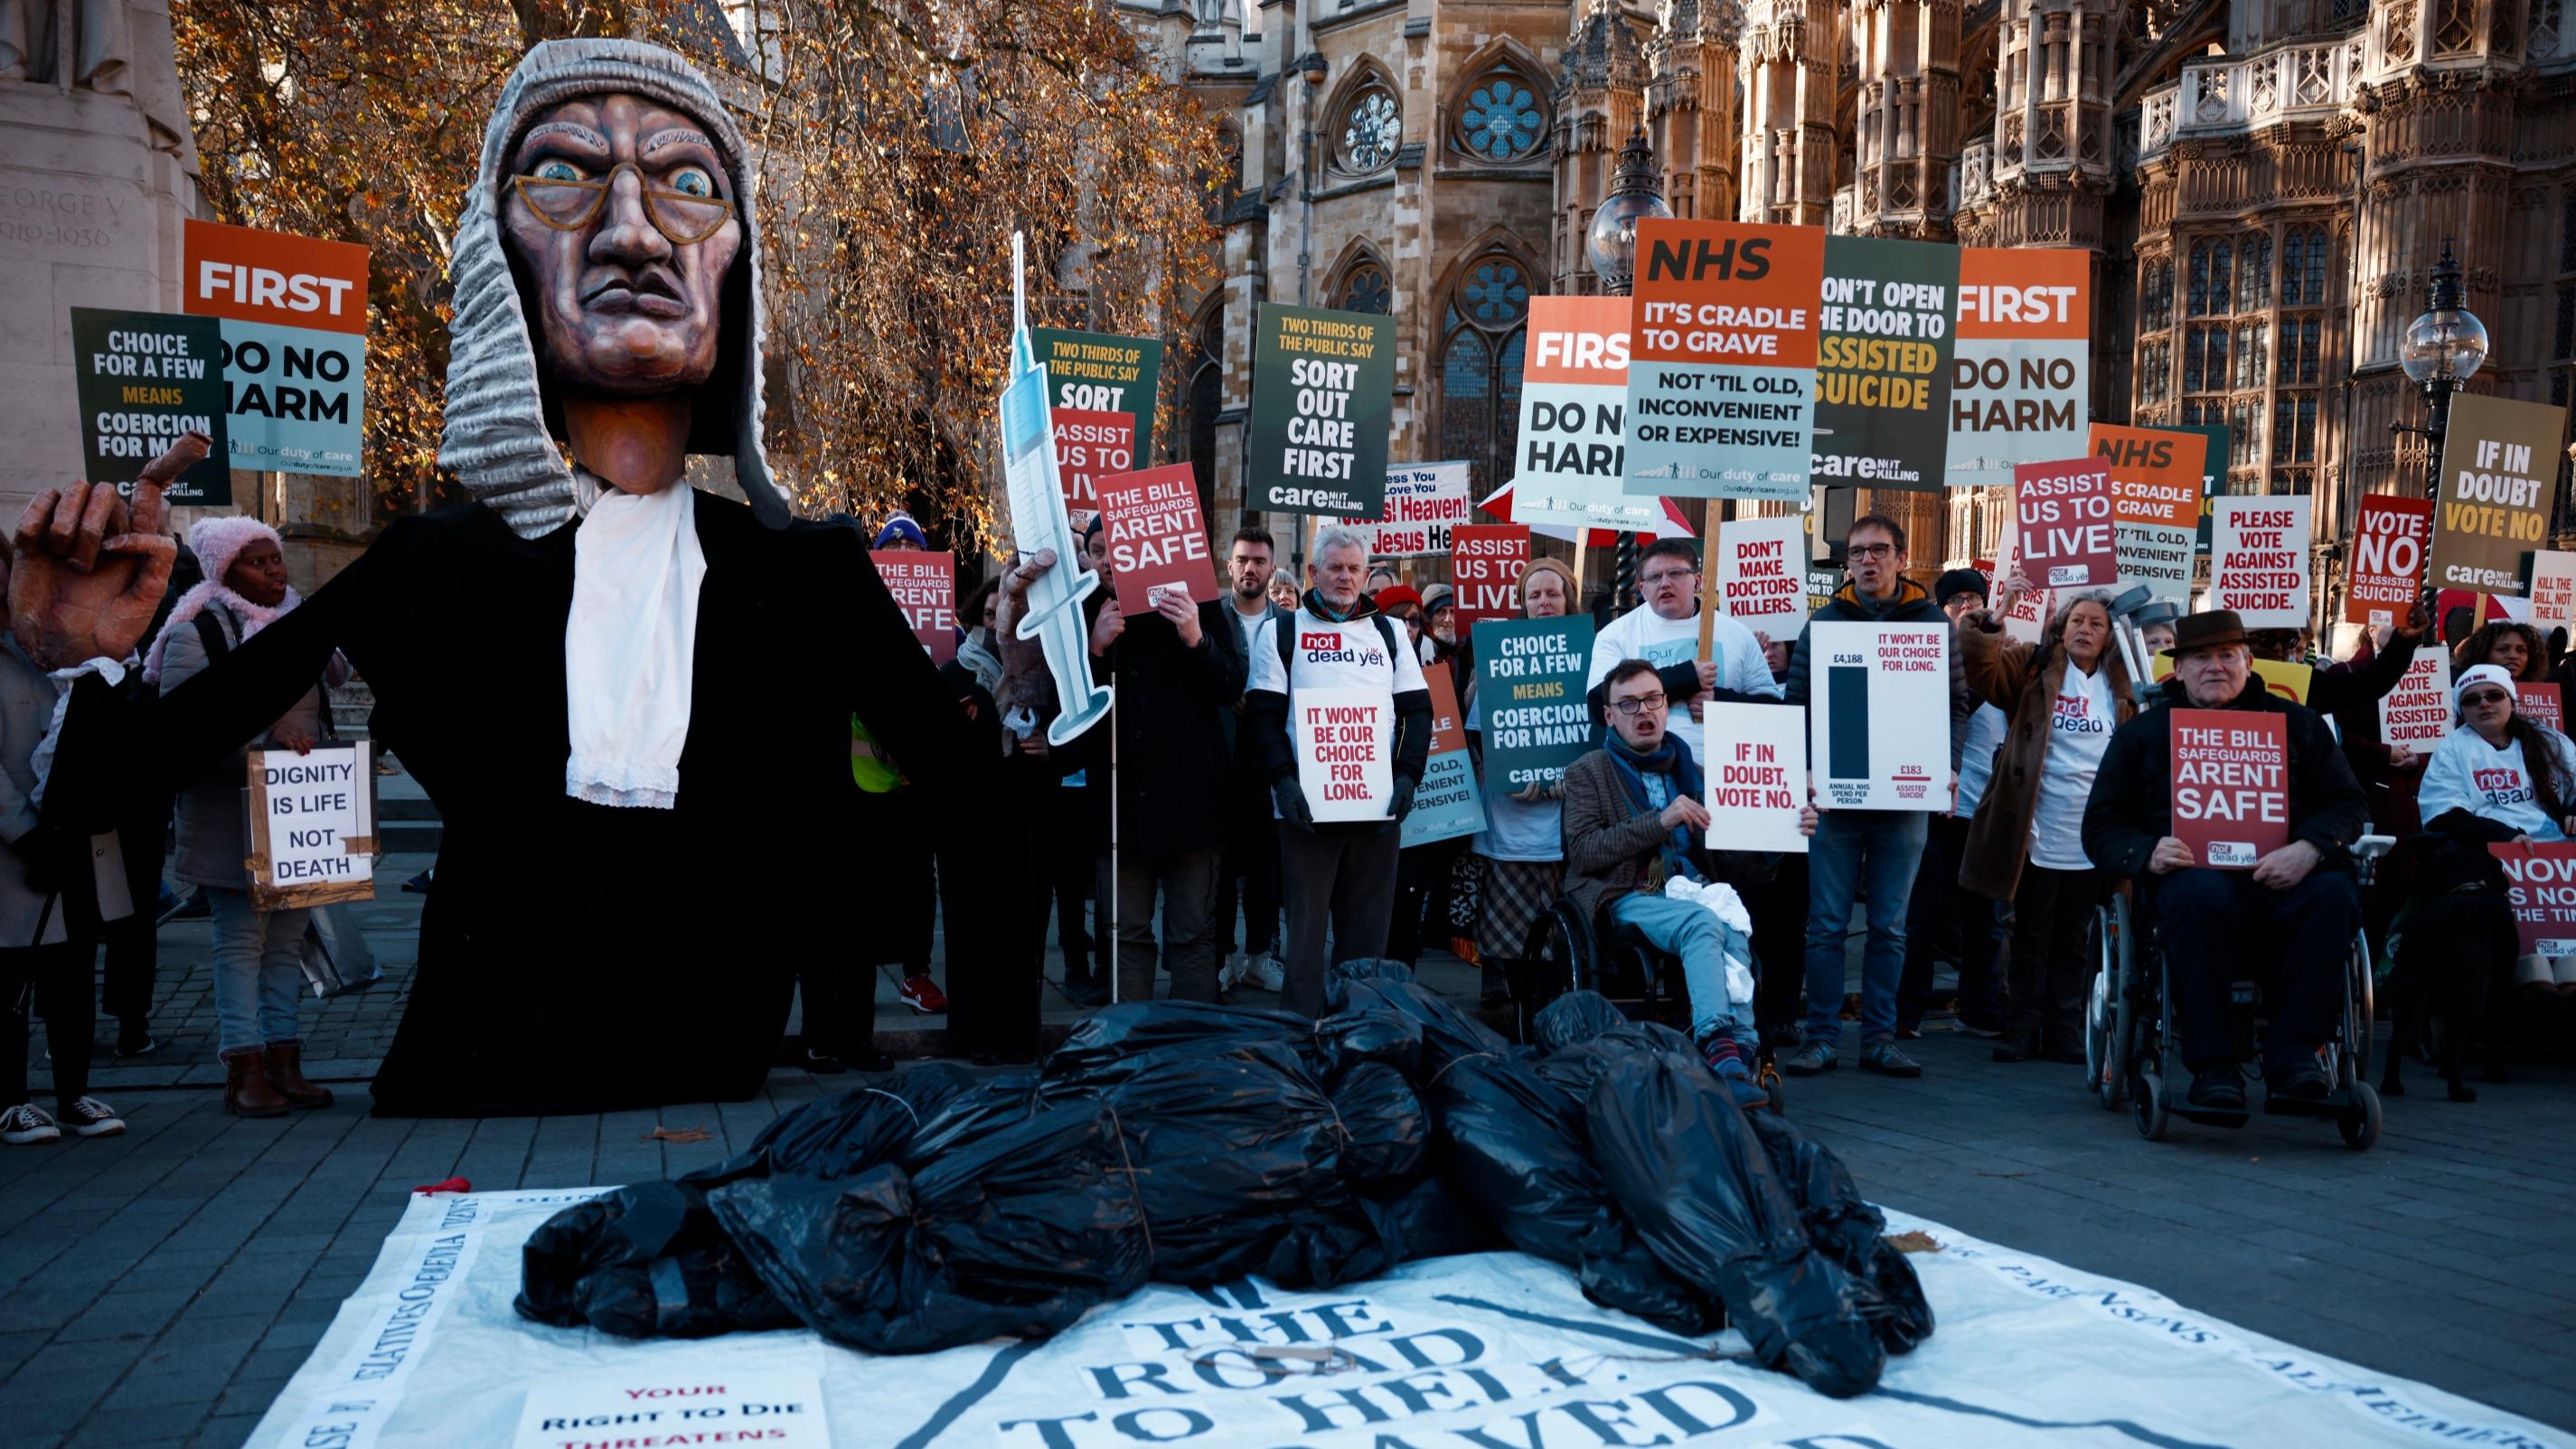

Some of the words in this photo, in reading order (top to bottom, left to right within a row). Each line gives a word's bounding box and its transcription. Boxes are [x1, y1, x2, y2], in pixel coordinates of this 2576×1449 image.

[107, 197, 125, 217] V
[1647, 238, 1772, 282] NHS
[200, 260, 353, 316] FIRST
[1884, 282, 1944, 310] OPEN
[1957, 286, 2076, 323] FIRST
[1697, 305, 1806, 330] CRADLE
[1847, 307, 1913, 337] DOOR
[1916, 313, 1945, 339] TO
[1281, 317, 1309, 333] TWO
[1312, 320, 1356, 339] THIRDS
[1358, 325, 1374, 341] OF
[108, 331, 188, 356] CHOICE
[1053, 342, 1078, 358] TWO
[1082, 344, 1123, 362] THIRDS
[1124, 349, 1141, 363] OF
[1304, 337, 1349, 356] PUBLIC
[1351, 343, 1374, 359] SAY
[1642, 329, 1679, 351] TO
[1687, 331, 1777, 355] GRAVE
[94, 353, 137, 376] FOR
[143, 356, 157, 377] A
[163, 357, 205, 380] FEW
[283, 345, 350, 382] NO
[1049, 360, 1072, 374] THE
[1074, 362, 1115, 380] PUBLIC
[1118, 366, 1140, 381] SAY
[1291, 358, 1359, 390] SORT
[1952, 358, 2009, 390] DO
[2021, 358, 2075, 390] NO
[123, 386, 183, 405] MEANS
[1059, 382, 1123, 412] SORT
[1297, 389, 1349, 419] OUT
[1530, 401, 1586, 434] DO
[1638, 398, 1802, 421] INCONVENIENT
[1952, 399, 2075, 432] HARM
[1288, 417, 1354, 448] CARE
[1637, 425, 1669, 442] OR
[1675, 426, 1800, 447] EXPENSIVE!
[98, 436, 143, 457] FOR
[258, 446, 278, 456] Our
[281, 447, 311, 460] duty
[313, 450, 323, 459] of
[324, 453, 353, 461] care
[2476, 439, 2500, 470] IF
[2504, 443, 2531, 475] IN
[1095, 448, 1130, 470] TO
[1283, 447, 1355, 479] FIRST
[1413, 472, 1435, 482] You
[1699, 468, 1721, 479] Our
[1724, 468, 1755, 483] duty
[1757, 471, 1768, 481] of
[1770, 472, 1800, 482] care
[1876, 469, 1920, 482] KILLING
[2019, 472, 2107, 498] ASSIST
[1104, 488, 1143, 508] THE
[1148, 481, 1191, 501] BILL
[1269, 486, 1329, 507] care
[1415, 484, 1436, 493] You
[2125, 483, 2193, 503] CRADLE
[2457, 470, 2541, 508] DOUBT
[1106, 497, 1194, 522] SAFEGUARDS
[1328, 499, 1363, 511] KILLING
[1402, 495, 1467, 522] Heaven!
[1569, 502, 1586, 512] Our
[1588, 503, 1615, 515] duty
[1614, 506, 1624, 514] of
[2019, 500, 2061, 524] US
[2116, 500, 2174, 518] GRAVE
[1111, 508, 1197, 542] ARENT
[2230, 511, 2294, 528] PLEASE
[2364, 510, 2424, 537] VOTE
[2445, 502, 2505, 537] VOTE
[1372, 529, 1424, 554] Jesus
[1456, 540, 1527, 555] ASSIST
[1737, 541, 1783, 559] DON'T
[2024, 524, 2111, 560] LIVE
[2158, 532, 2187, 548] OLD,
[2239, 532, 2282, 549] VOTE
[1113, 532, 1208, 572] SAFE
[2223, 552, 2297, 569] AGAINST
[2356, 533, 2419, 577] NO
[875, 564, 908, 577] THE
[914, 565, 949, 579] BILL
[1456, 560, 1488, 579] US
[1739, 560, 1783, 578] MAKE
[1810, 572, 1833, 584] OPEN
[1726, 578, 1799, 597] DOCTORS
[2219, 572, 2299, 589] ASSISTED
[2355, 574, 2366, 584] TO
[2369, 575, 2414, 587] ASSISTED
[2537, 577, 2553, 589] KILL
[2223, 593, 2294, 610] SUICIDE.
[2353, 585, 2414, 603] SUICIDE
[2534, 592, 2552, 606] BILL,
[2555, 594, 2571, 606] NOT
[1730, 597, 1796, 616] KILLERS.
[2552, 607, 2565, 619] ILL.
[1307, 636, 1336, 648] not
[1501, 634, 1567, 657] CHOICE
[1879, 634, 1888, 644] IT
[1890, 634, 1923, 645] WON'T
[1927, 635, 1940, 645] BE
[1308, 649, 1355, 663] dead
[1359, 652, 1384, 666] yet
[1834, 654, 1863, 664] £4,188
[1878, 647, 1899, 658] OUR
[1903, 647, 1941, 658] CHOICE
[1529, 657, 1542, 675] A
[1546, 653, 1582, 673] FEW
[1883, 661, 1903, 671] FOR
[1905, 662, 1936, 672] LONG.
[1513, 682, 1564, 700] MEANS
[2388, 692, 2442, 708] AGAINST
[2524, 694, 2557, 707] BILL
[1307, 708, 1321, 724] IT
[1325, 707, 1377, 723] WON'T
[1492, 703, 1589, 729] COERCION
[2053, 715, 2102, 732] dead
[1314, 727, 1335, 743] BE
[1340, 726, 1374, 742] OUR
[1535, 723, 1592, 746] MANY
[2390, 725, 2445, 740] SUICIDE.
[1315, 745, 1376, 763] CHOICE
[1736, 743, 1752, 761] IF
[1757, 744, 1774, 762] IN
[2178, 748, 2280, 762] SAFEGUARDS
[266, 764, 353, 786] DIGNITY
[1330, 765, 1363, 781] FOR
[1724, 766, 1788, 789] DOUBT,
[1901, 766, 1922, 775] £183
[2177, 762, 2283, 787] ARENT
[1323, 784, 1372, 801] LONG.
[1766, 790, 1796, 809] NO.
[273, 797, 293, 814] IS
[301, 793, 346, 813] LIFE
[2176, 788, 2285, 823] SAFE
[290, 829, 334, 848] NOT
[277, 857, 351, 879] DEATH
[1083, 1328, 1485, 1398] ROAD
[625, 1386, 726, 1400] YOUR
[541, 1411, 664, 1430] RIGHT
[742, 1403, 804, 1416] DIE
[557, 1428, 785, 1449] THREATENS
